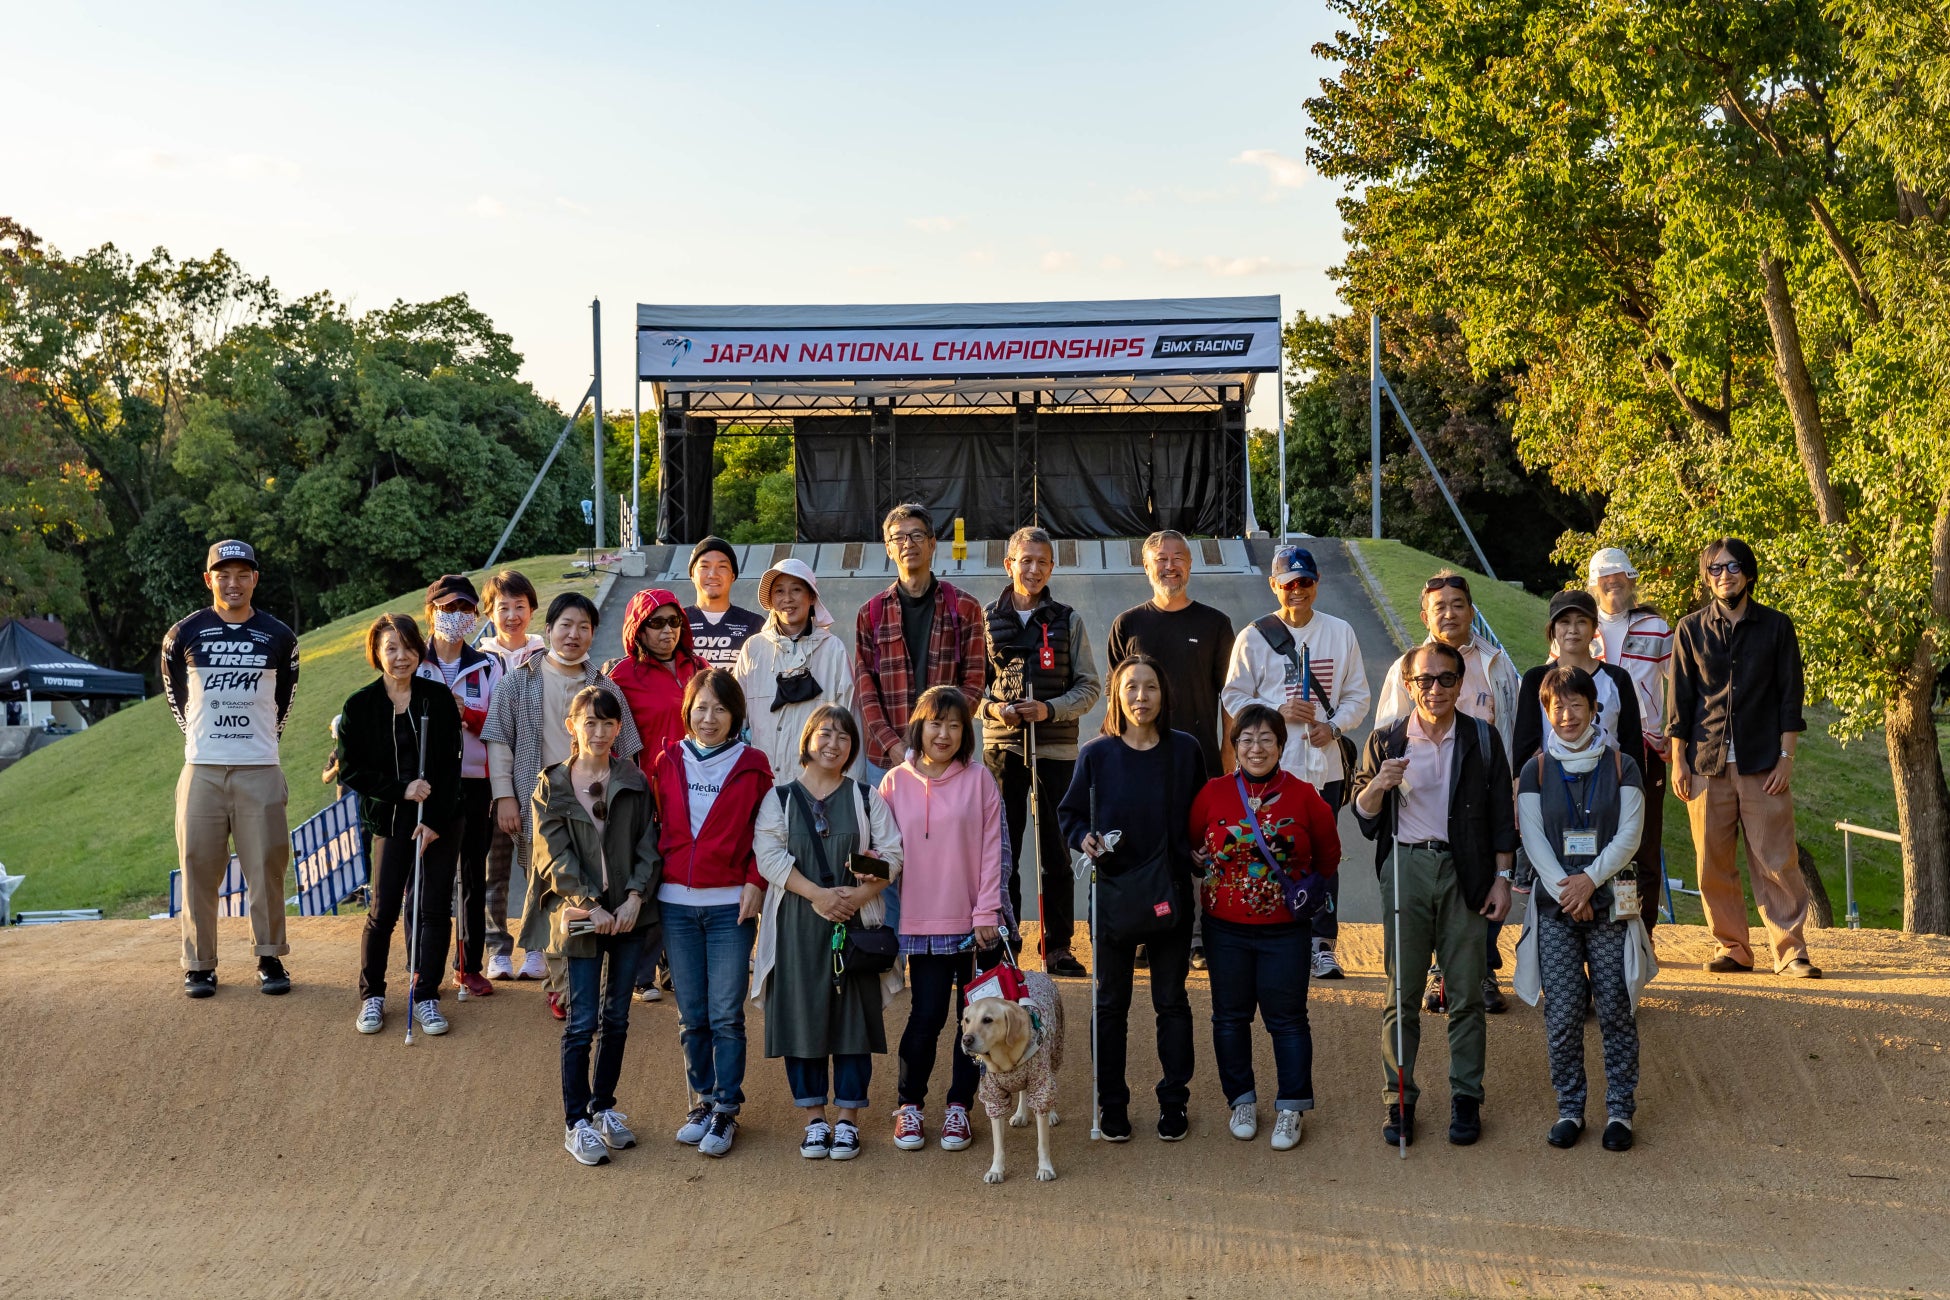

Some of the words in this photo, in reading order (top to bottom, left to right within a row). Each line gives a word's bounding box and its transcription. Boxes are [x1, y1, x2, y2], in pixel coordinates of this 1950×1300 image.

[661, 338, 680, 346] JCF
[1161, 341, 1192, 352] BMX
[1194, 339, 1245, 352] RACING
[702, 343, 790, 363] JAPAN
[798, 341, 924, 363] NATIONAL
[932, 337, 1146, 361] CHAMPIONSHIPS
[218, 545, 241, 554] TOYO
[201, 640, 254, 653] TOYO
[692, 636, 732, 648] OYO
[208, 653, 268, 667] TIRES
[43, 676, 63, 686] TOYO
[63, 677, 84, 688] TIRES
[203, 670, 263, 694] LEFLAH
[213, 714, 250, 728] JATO
